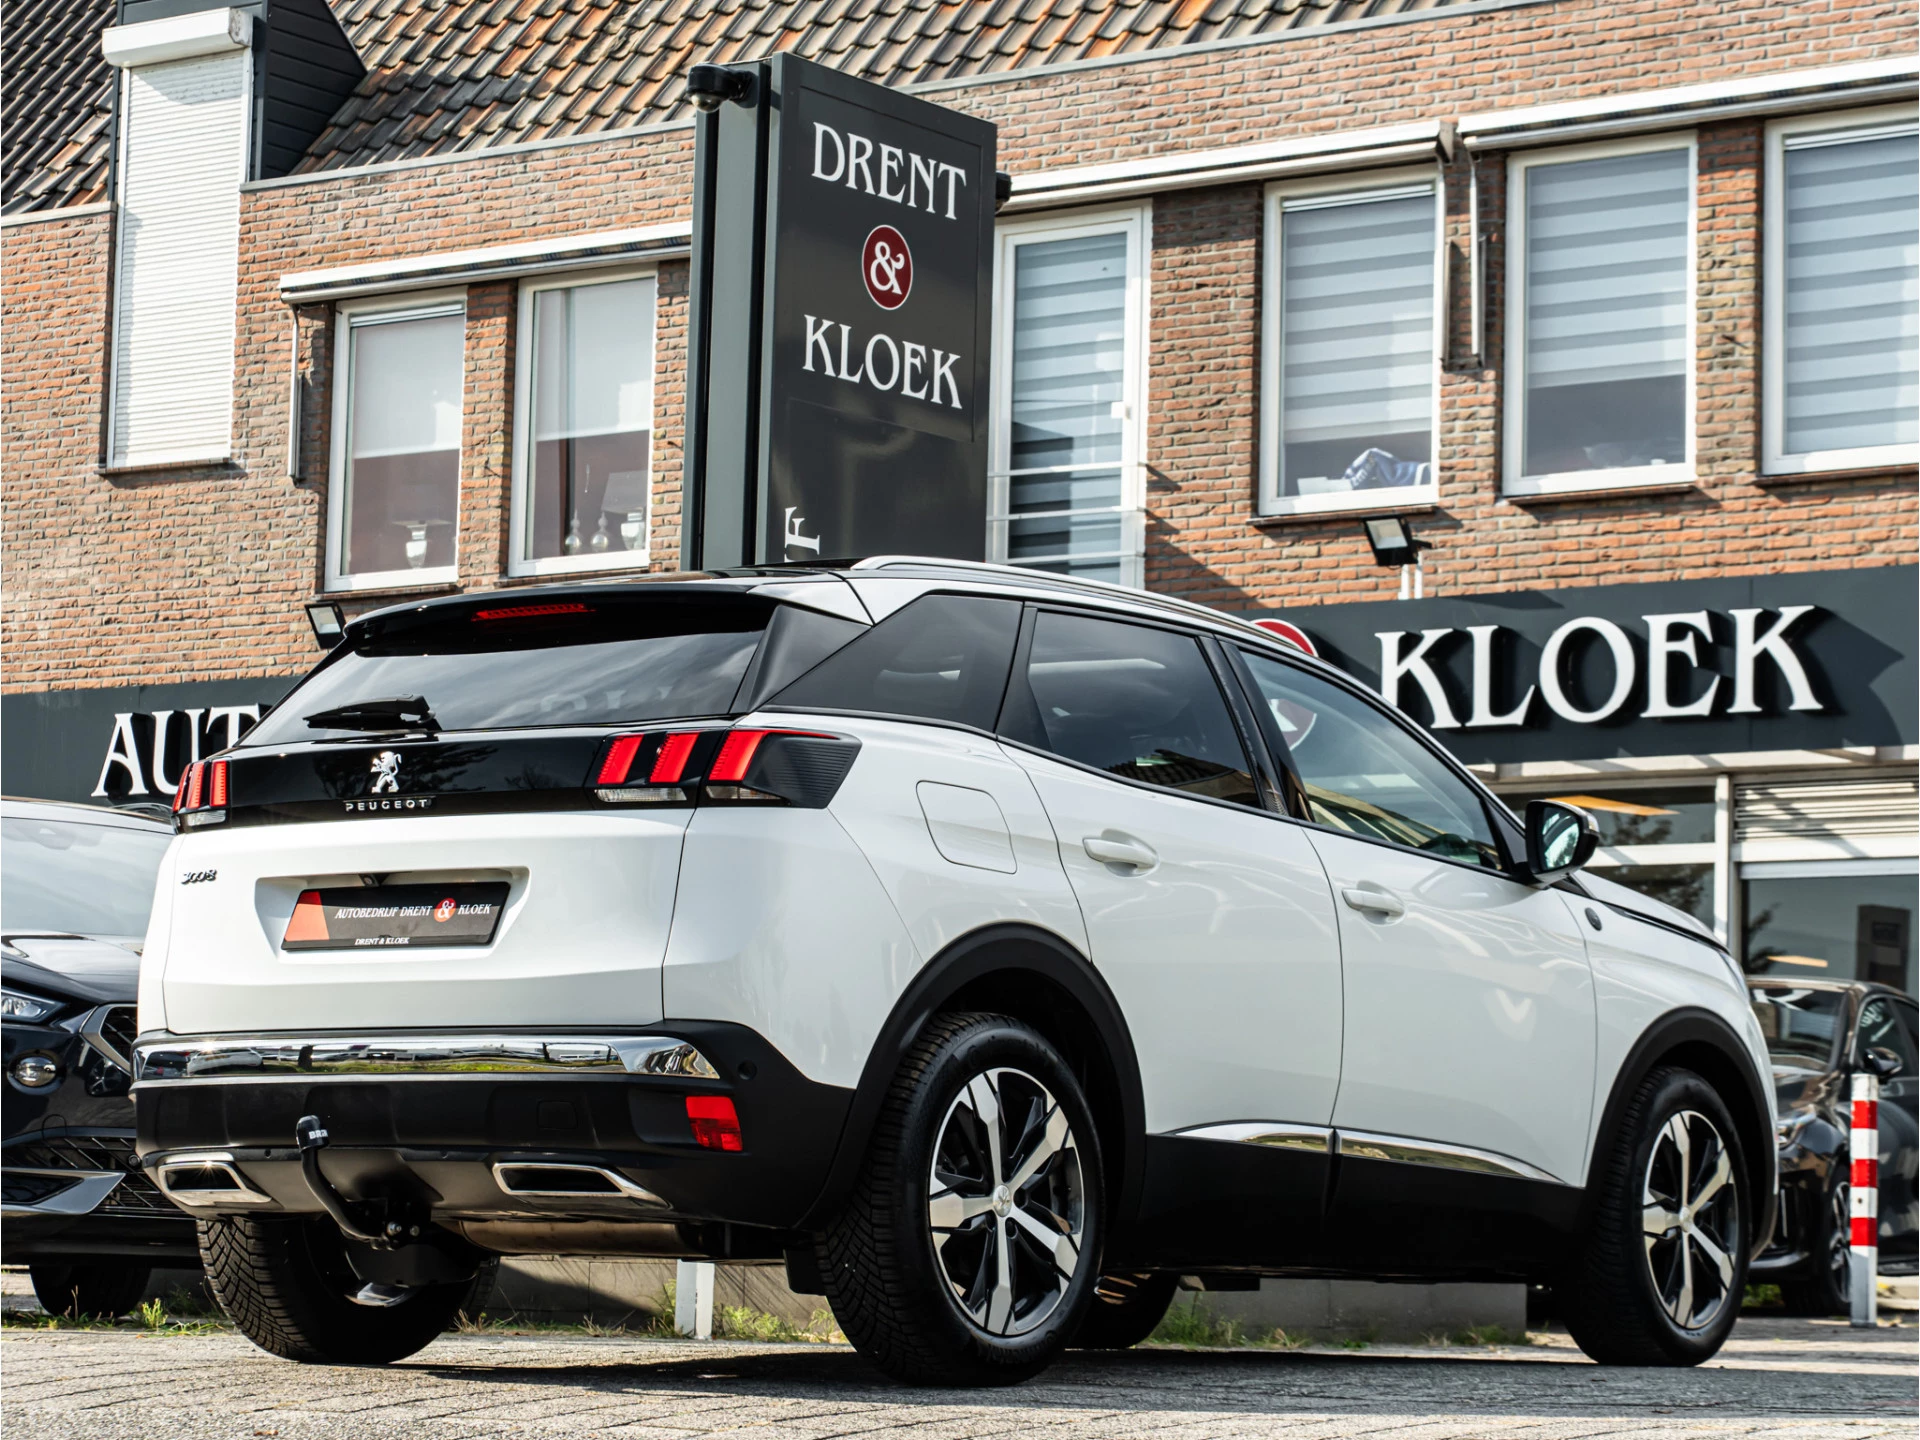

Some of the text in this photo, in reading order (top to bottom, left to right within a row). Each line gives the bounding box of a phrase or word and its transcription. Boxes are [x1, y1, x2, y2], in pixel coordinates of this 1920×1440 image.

[812, 121, 967, 220] DRENT
[869, 240, 906, 296] &
[802, 313, 963, 410] KLOEK
[1375, 604, 1824, 730] KLOEK
[345, 799, 428, 812] PEUGEOT
[181, 869, 217, 885] 3008
[334, 900, 492, 919] AUTOBEDRIJF DRENT & KLOEK
[354, 937, 410, 946] DRENT & KLOEK
